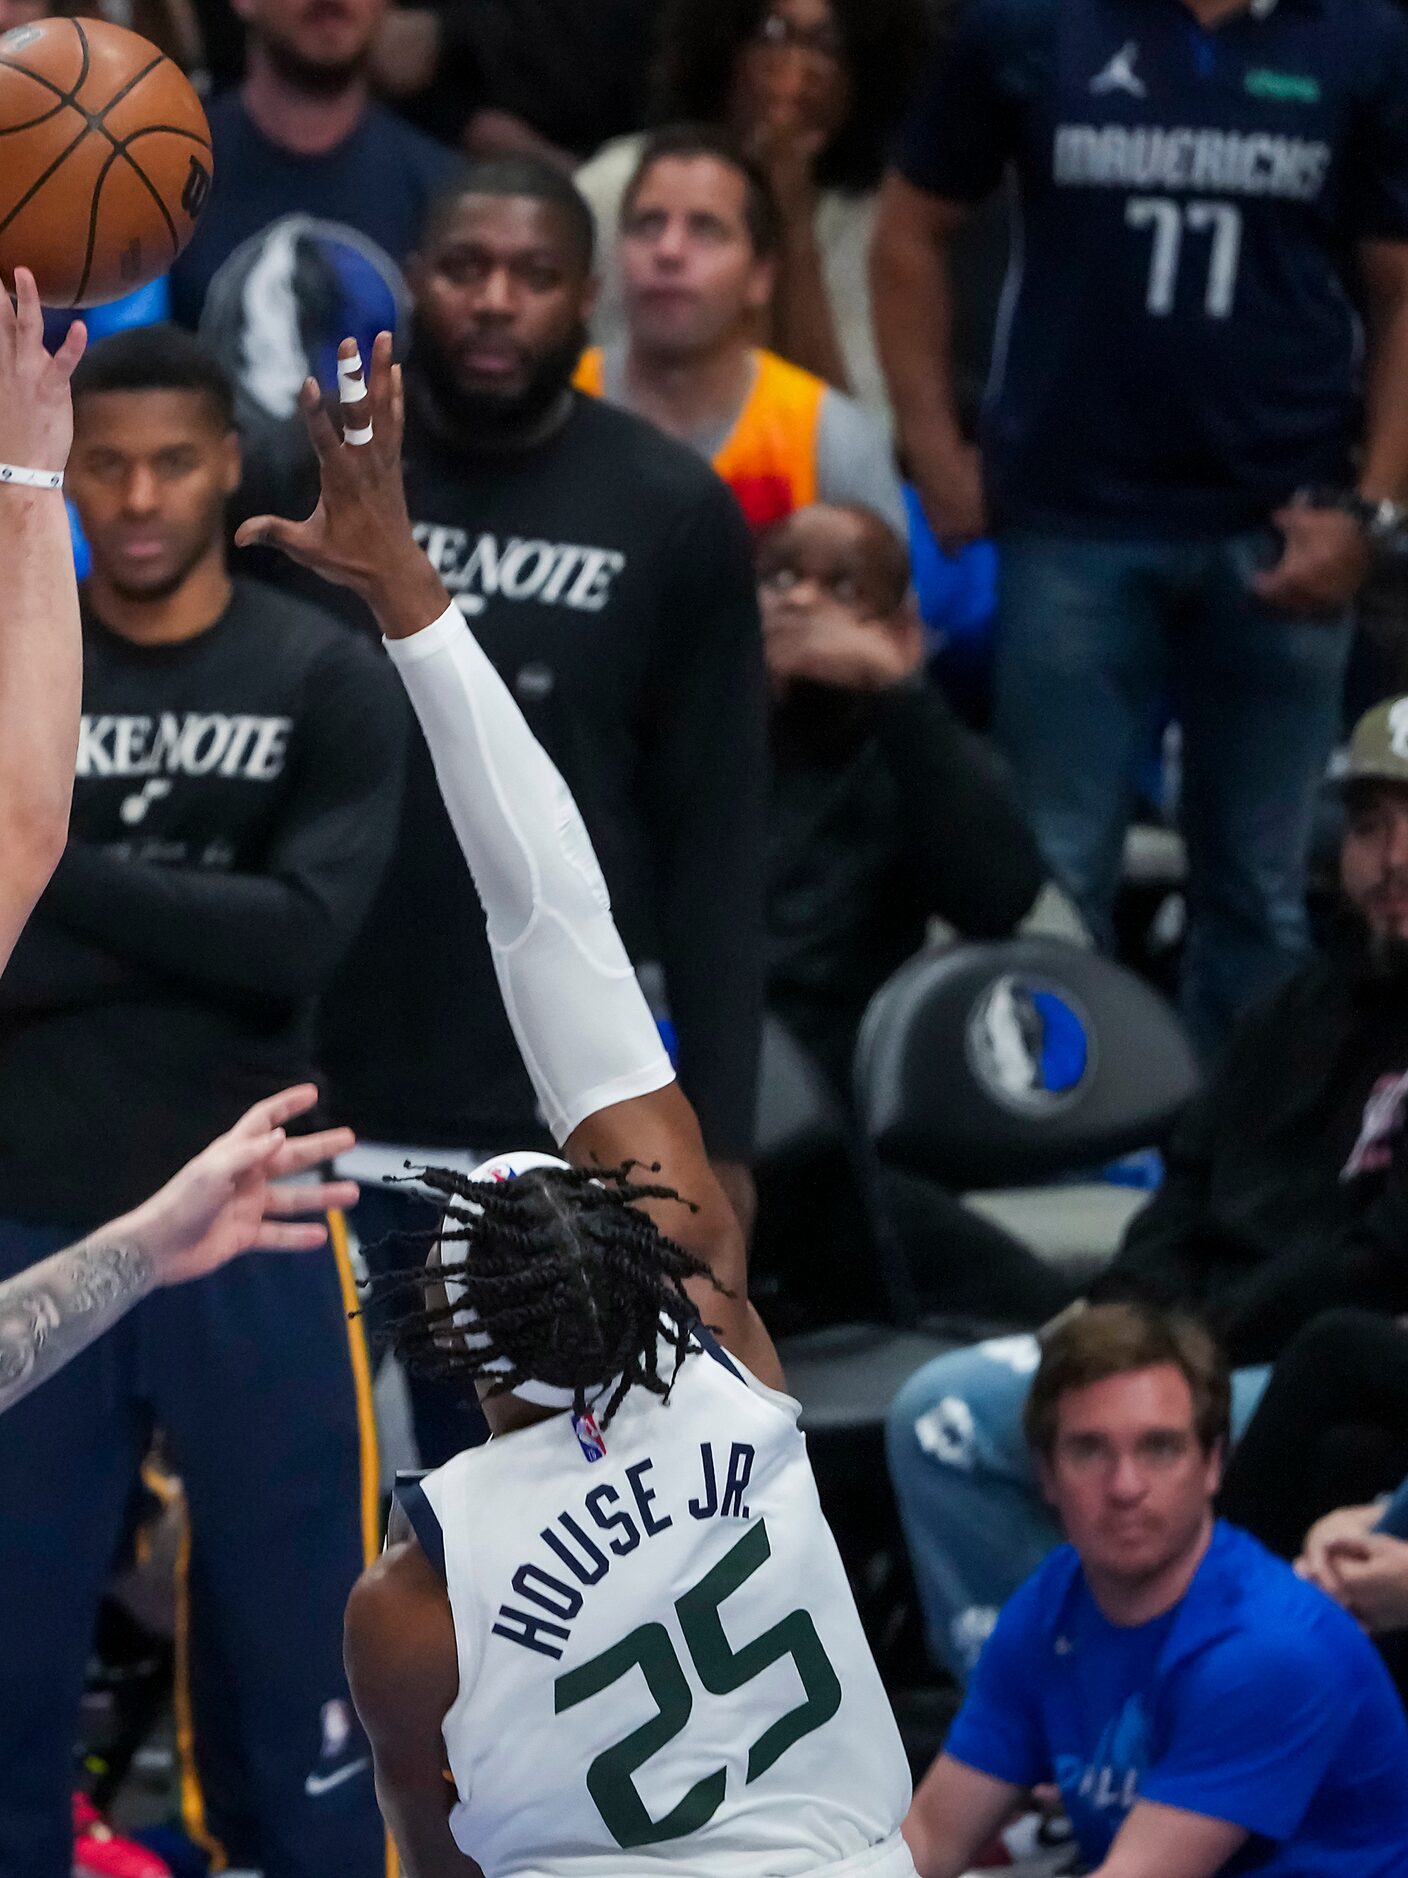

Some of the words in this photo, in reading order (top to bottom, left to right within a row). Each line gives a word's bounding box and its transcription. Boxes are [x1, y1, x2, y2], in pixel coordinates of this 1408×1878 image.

[1125, 196, 1242, 317] 77
[492, 1457, 673, 1660] HOUSE
[688, 1442, 755, 1520] JR.
[555, 1516, 842, 1849] 25
